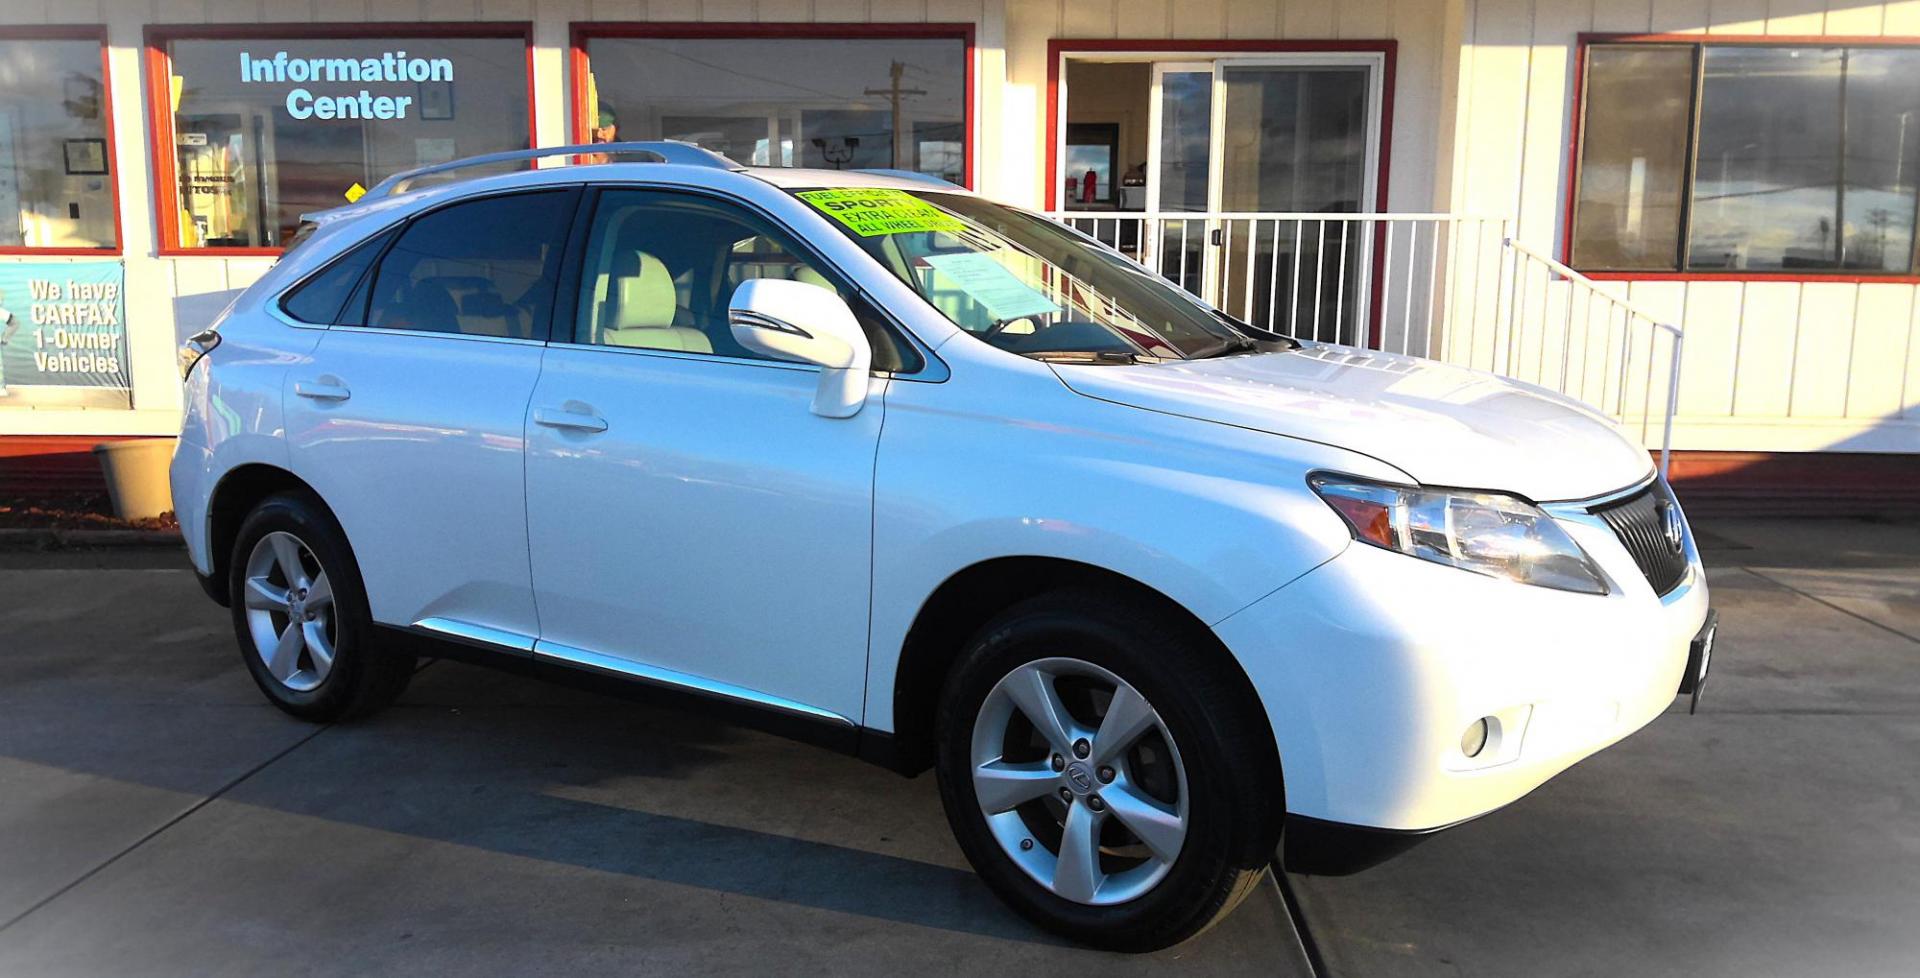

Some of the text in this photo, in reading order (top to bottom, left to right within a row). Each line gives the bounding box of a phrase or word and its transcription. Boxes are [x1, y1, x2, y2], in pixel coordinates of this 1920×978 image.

[240, 52, 454, 82] Information
[286, 88, 412, 120] Center
[802, 192, 840, 200] FUEL
[825, 198, 917, 211] SPORTY
[842, 207, 941, 223] EXTRA CLEAN
[857, 223, 882, 232] ALL
[885, 220, 923, 230] WHEEL
[29, 278, 119, 301] We have
[31, 302, 118, 326] CARFAX
[33, 328, 120, 350] 1-Owner
[33, 351, 119, 373] Vehicles
